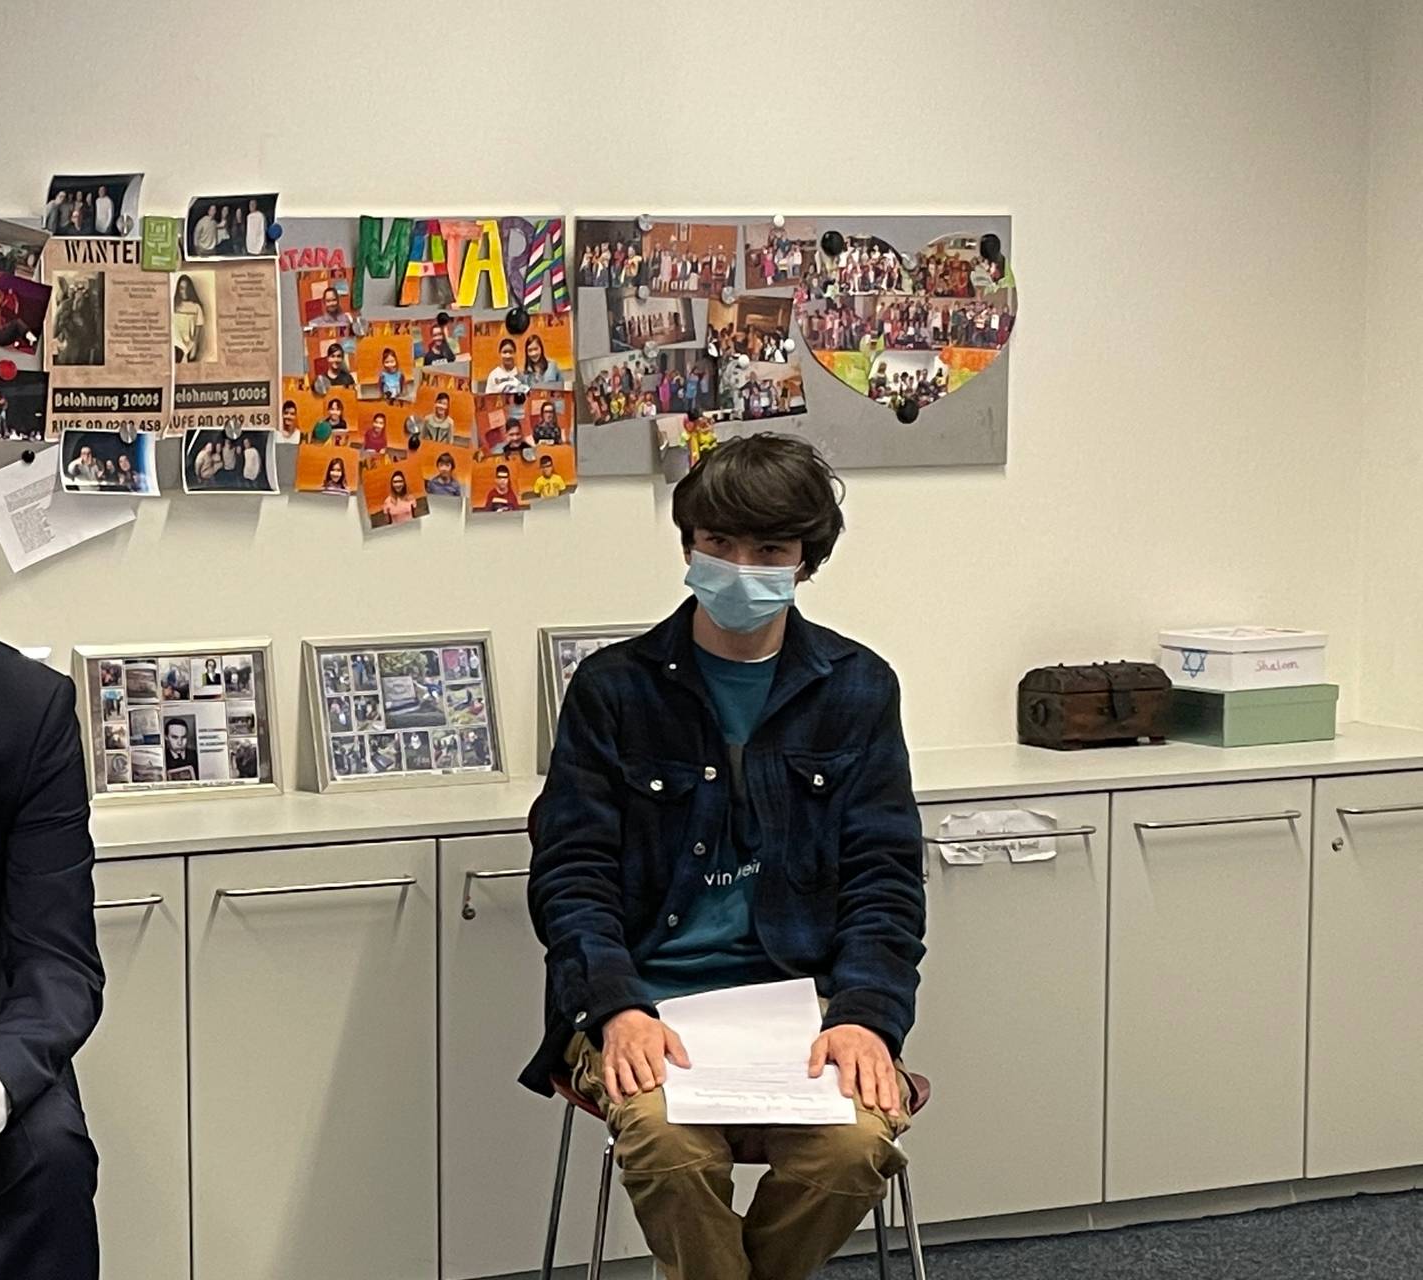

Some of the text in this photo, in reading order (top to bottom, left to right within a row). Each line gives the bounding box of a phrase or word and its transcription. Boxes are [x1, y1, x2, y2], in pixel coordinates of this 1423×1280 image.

[64, 239, 140, 265] WANTE
[353, 214, 572, 312] MATARA
[54, 391, 160, 411] Belohnung 1000$
[175, 386, 267, 406] elohnung 1000$
[139, 419, 161, 432] 458
[169, 414, 195, 429] UFE
[249, 413, 271, 425] 458
[1254, 659, 1299, 673] Shalom
